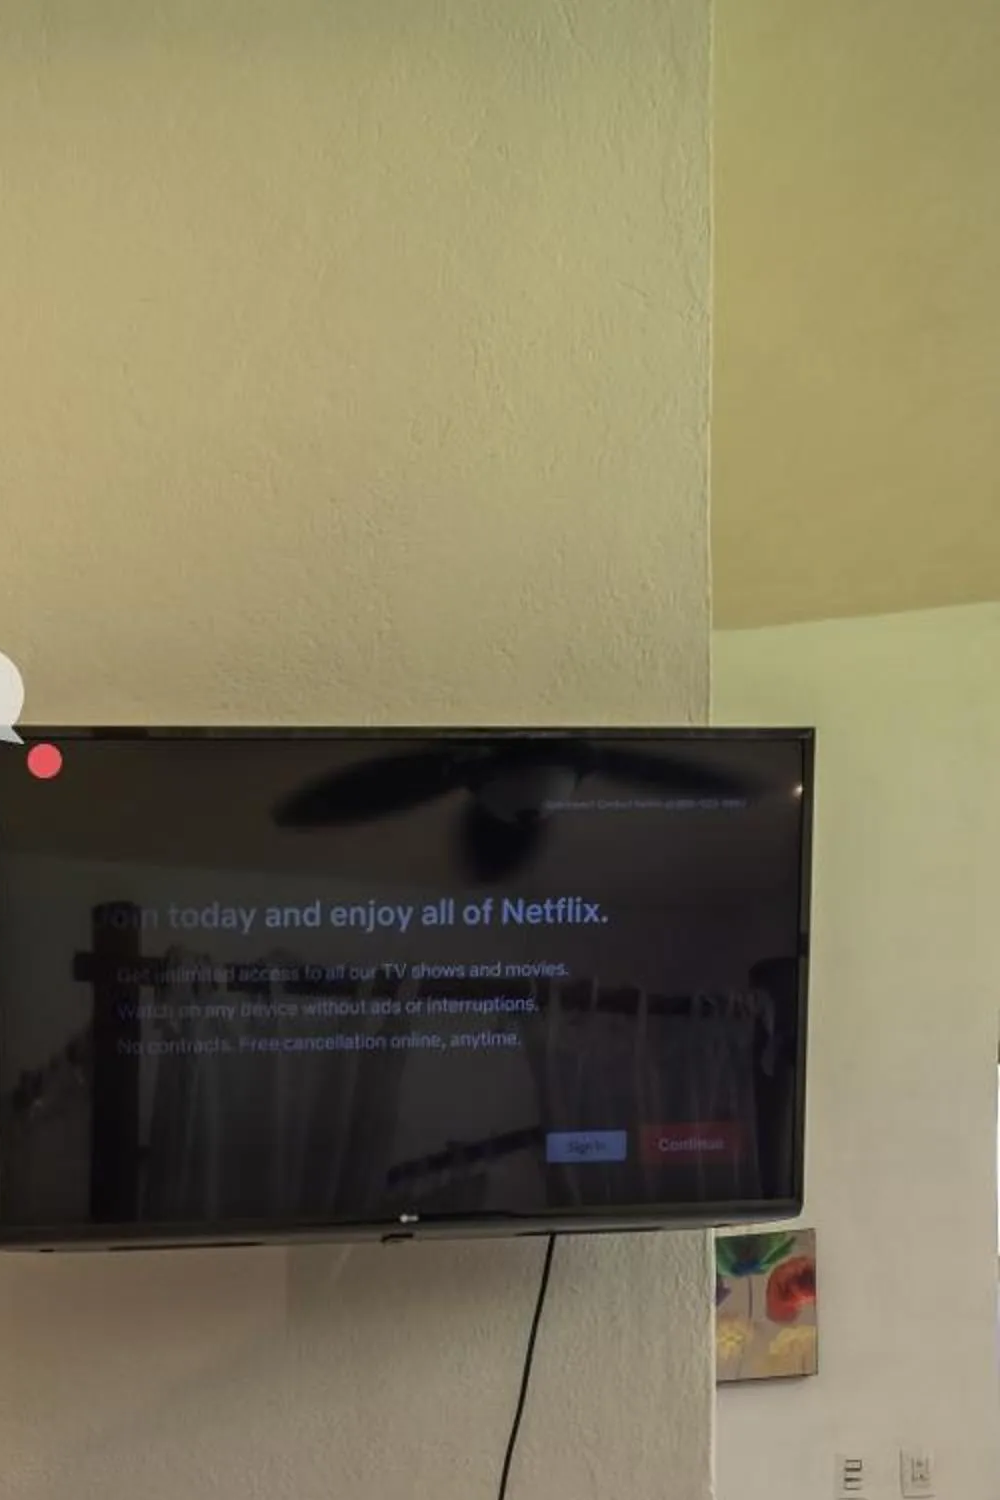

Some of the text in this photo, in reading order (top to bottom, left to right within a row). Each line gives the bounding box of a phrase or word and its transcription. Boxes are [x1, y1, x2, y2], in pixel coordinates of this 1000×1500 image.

[169, 901, 257, 935] today
[265, 898, 321, 928] and
[330, 899, 413, 935] enjoy
[421, 897, 455, 926] all
[462, 897, 494, 926] of
[501, 896, 609, 926] Netflix.
[239, 967, 299, 983] access
[304, 964, 323, 981] to
[325, 963, 346, 980] all
[350, 966, 376, 980] our
[382, 962, 408, 979] TV
[410, 962, 465, 979] shows
[469, 961, 501, 978] and
[504, 960, 569, 978] movies.
[204, 1004, 235, 1021] any
[241, 1001, 299, 1018] device
[302, 997, 367, 1017] without
[371, 998, 401, 1014] ads
[404, 999, 422, 1014] or
[426, 996, 540, 1018] interruptions.
[117, 1038, 140, 1055] No
[239, 1036, 279, 1052] Free
[283, 1032, 386, 1051] cancellation
[390, 1032, 447, 1051] online,
[450, 1030, 522, 1050] anytime.
